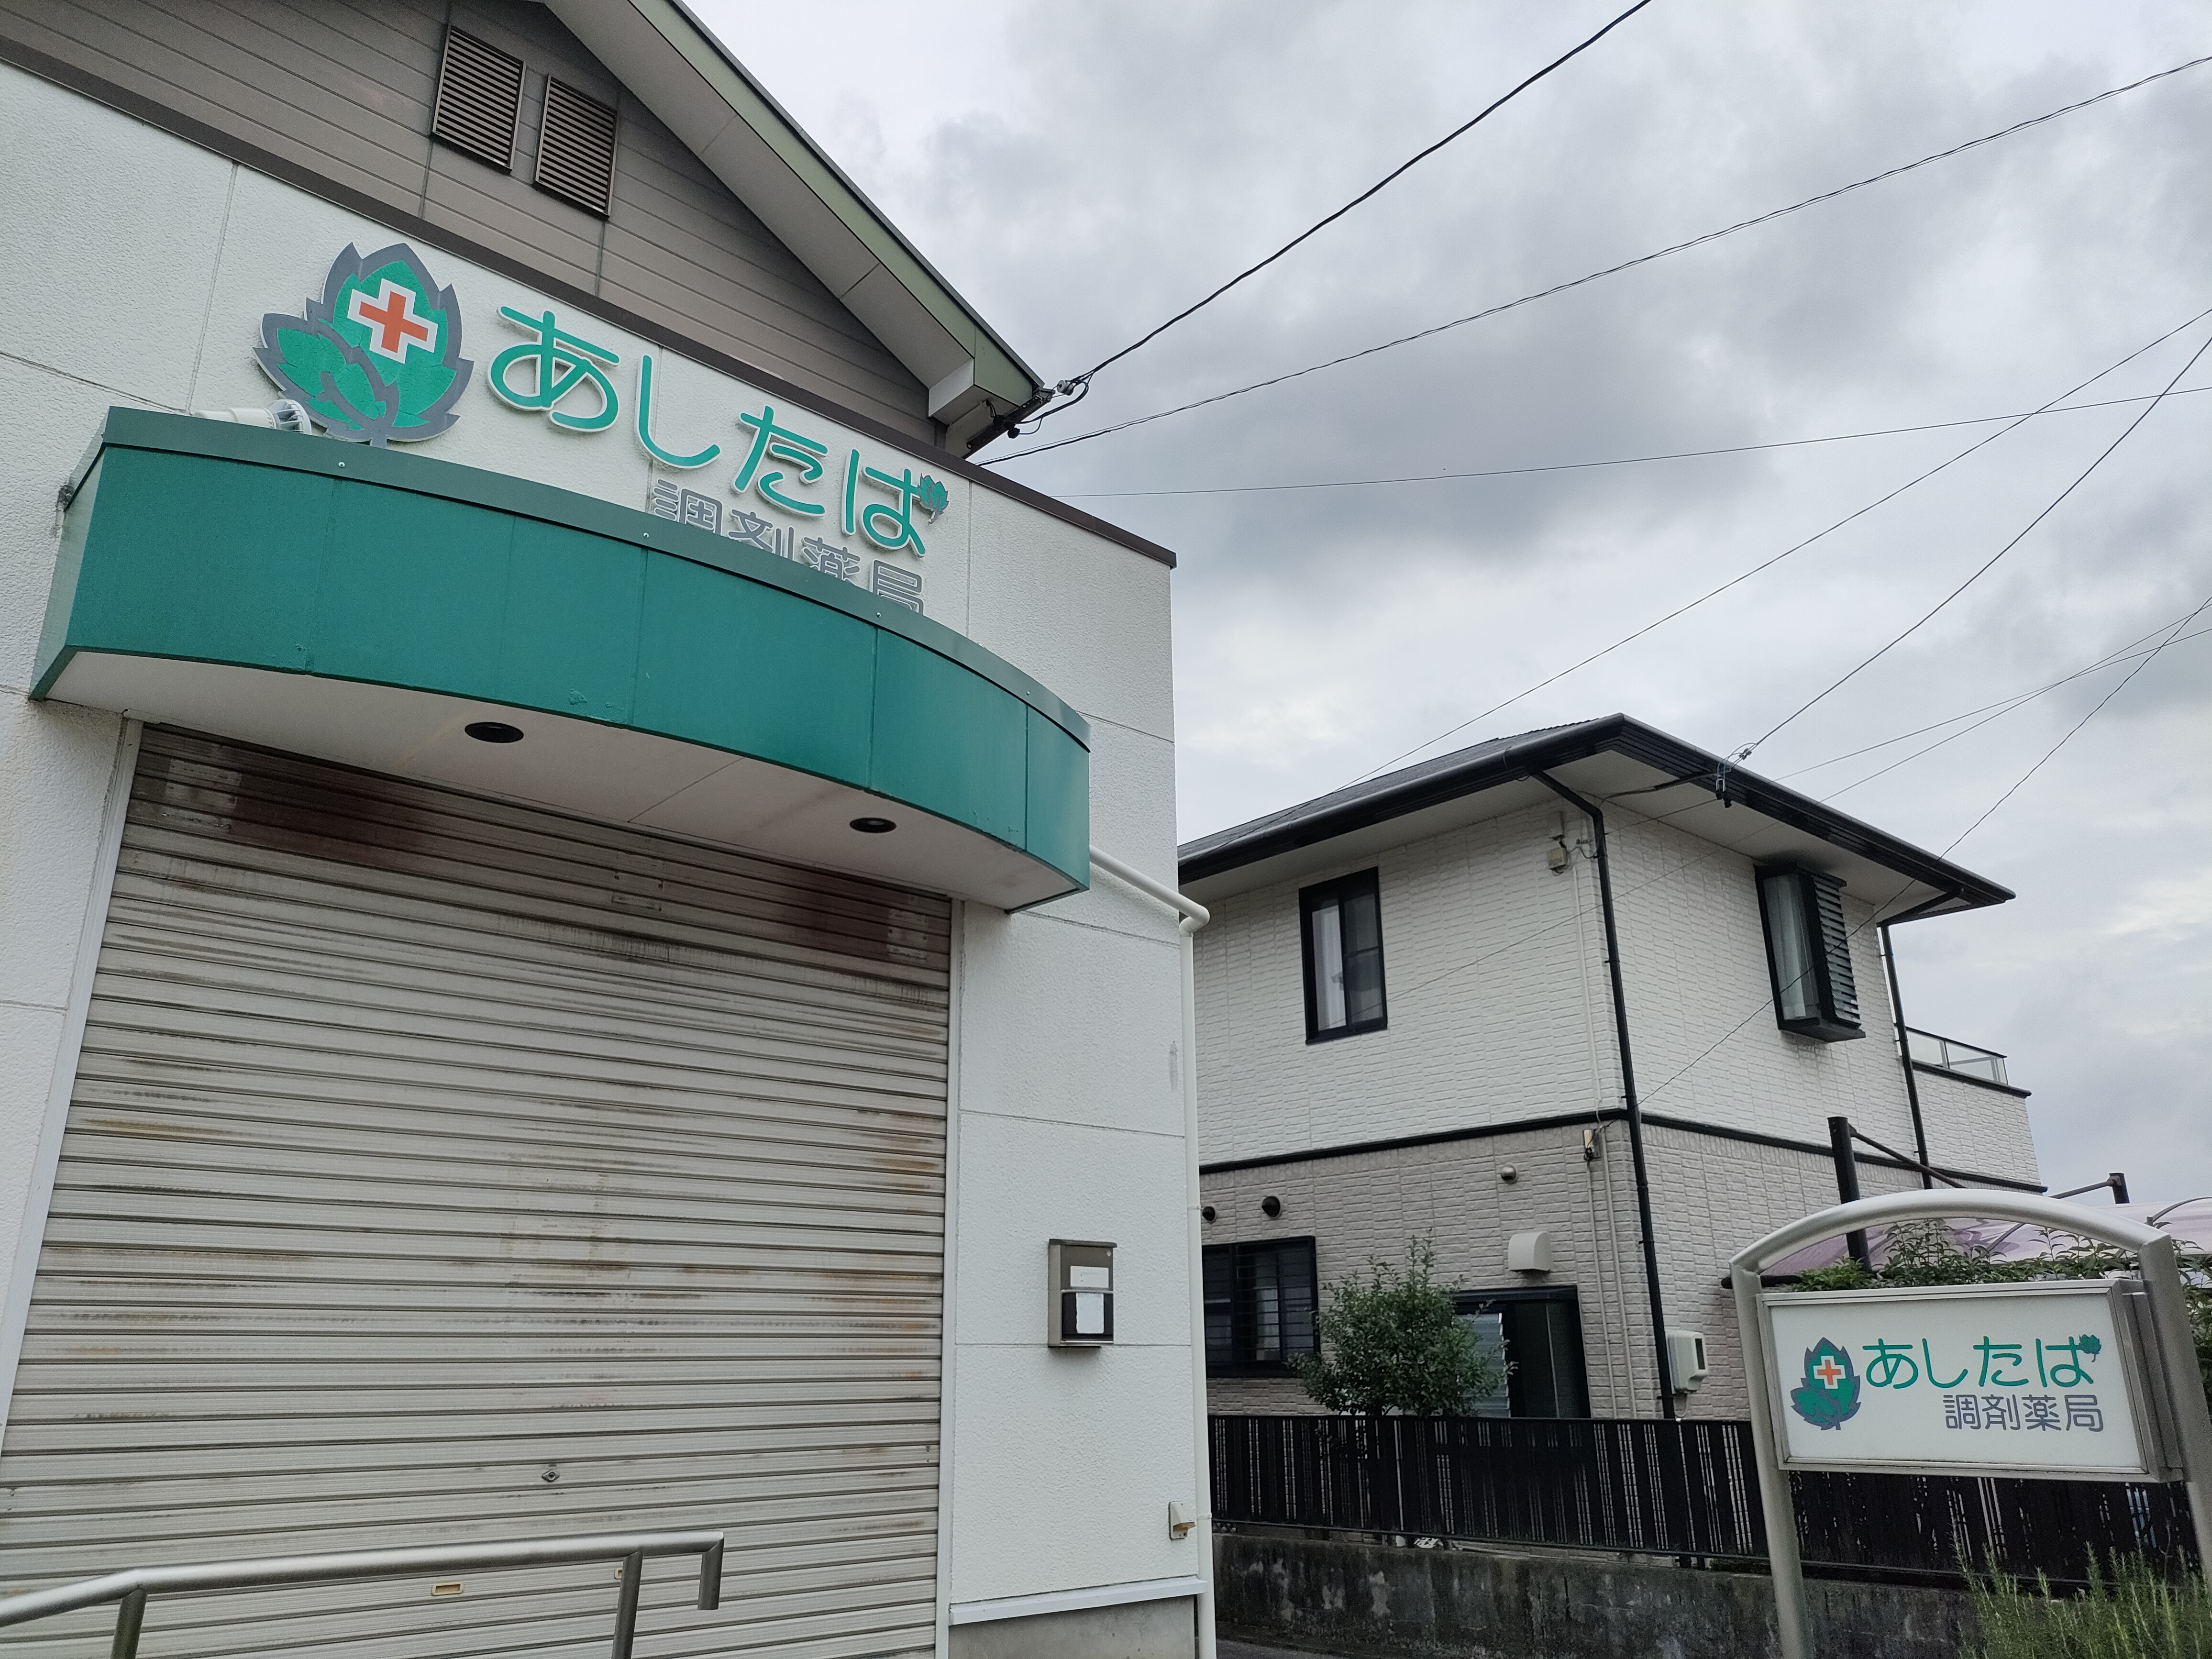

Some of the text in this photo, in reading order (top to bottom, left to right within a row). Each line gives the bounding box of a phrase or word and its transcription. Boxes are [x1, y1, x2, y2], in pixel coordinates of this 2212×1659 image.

[487, 304, 950, 558] あしたば
[1862, 1333, 2102, 1390] あしたば
[1942, 1394, 2104, 1433] 調剤薬局
